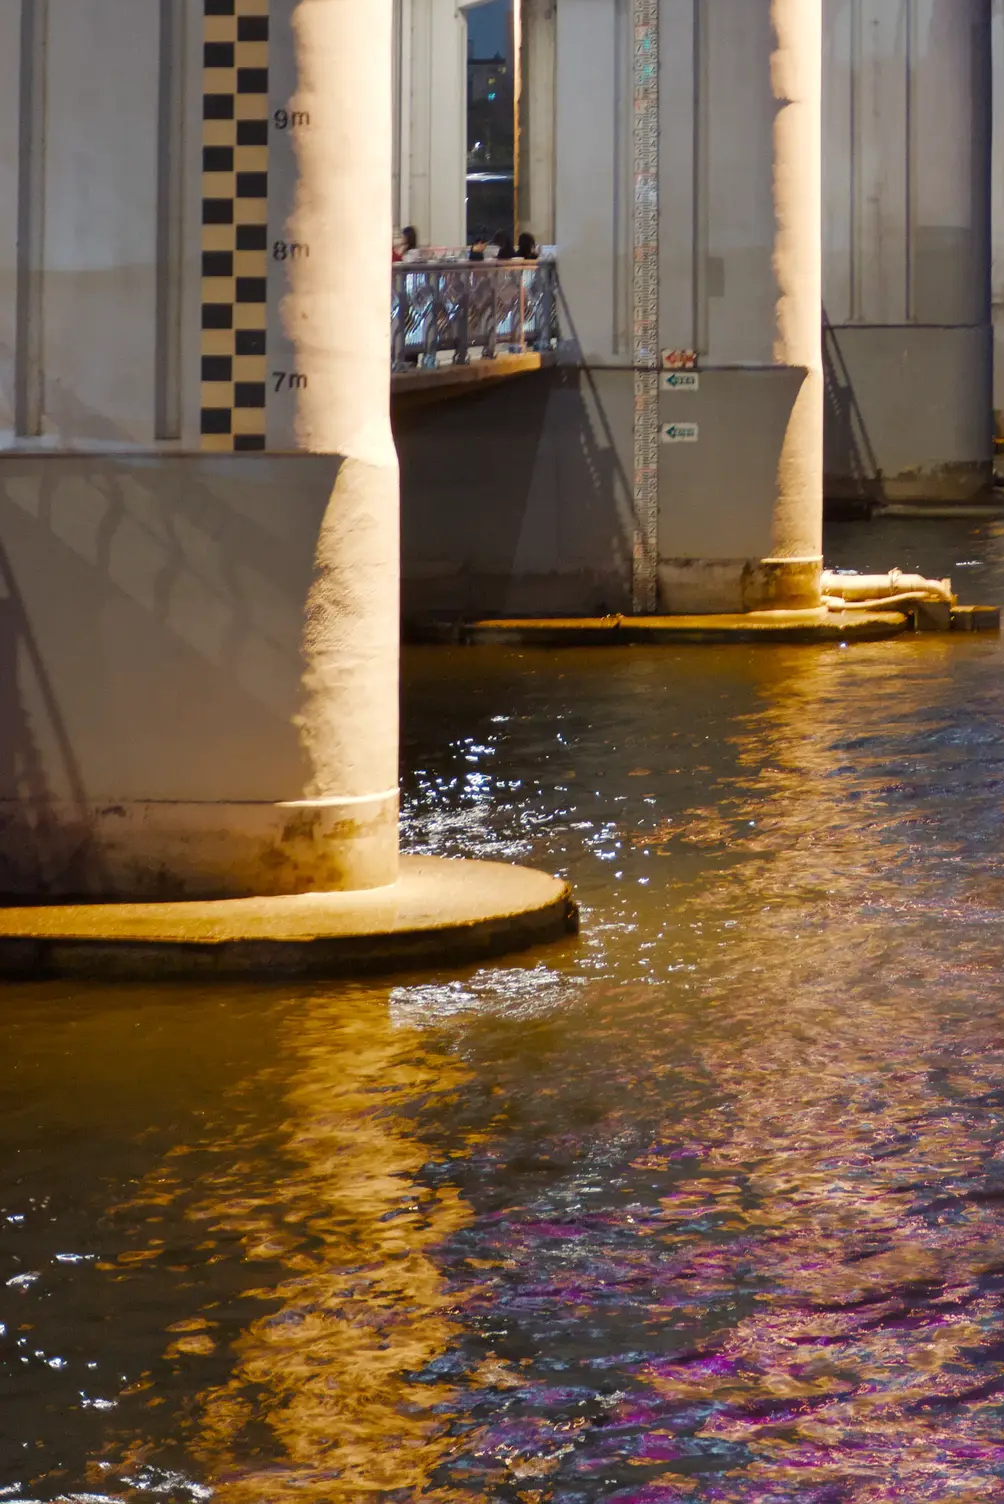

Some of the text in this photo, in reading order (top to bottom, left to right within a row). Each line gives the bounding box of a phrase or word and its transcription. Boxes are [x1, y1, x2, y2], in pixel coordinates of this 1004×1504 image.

[274, 108, 310, 130] 9m
[272, 239, 310, 261] 8m
[272, 371, 308, 393] 7m
